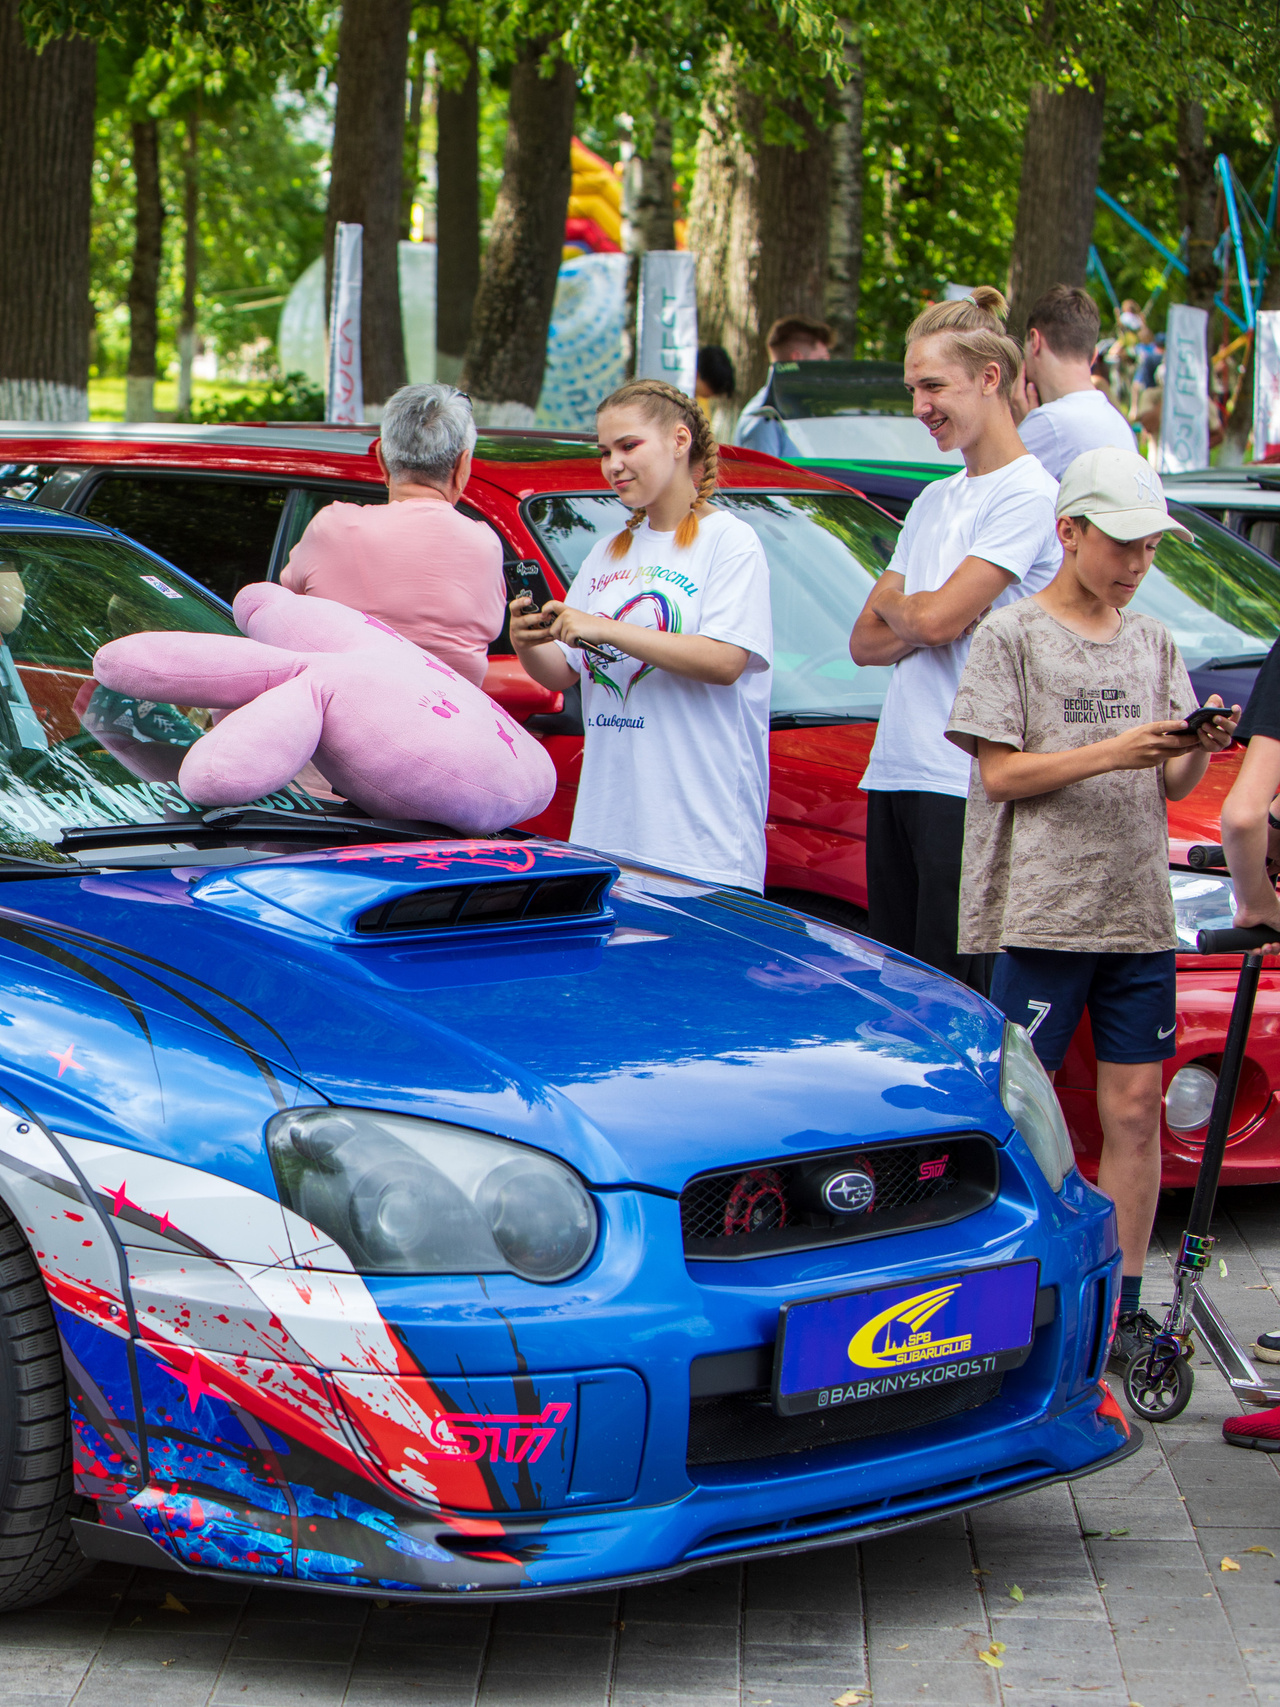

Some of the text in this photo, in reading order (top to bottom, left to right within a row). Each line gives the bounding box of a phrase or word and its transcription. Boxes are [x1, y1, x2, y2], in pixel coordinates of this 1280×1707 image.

[587, 565, 699, 598] Звуки радости
[1064, 699, 1095, 711] DECIDE
[1105, 704, 1141, 718] LET'S GO
[1064, 711, 1099, 724] QUICKLY
[908, 1330, 932, 1347] SPB
[895, 1340, 972, 1366] SUBARUCLUB
